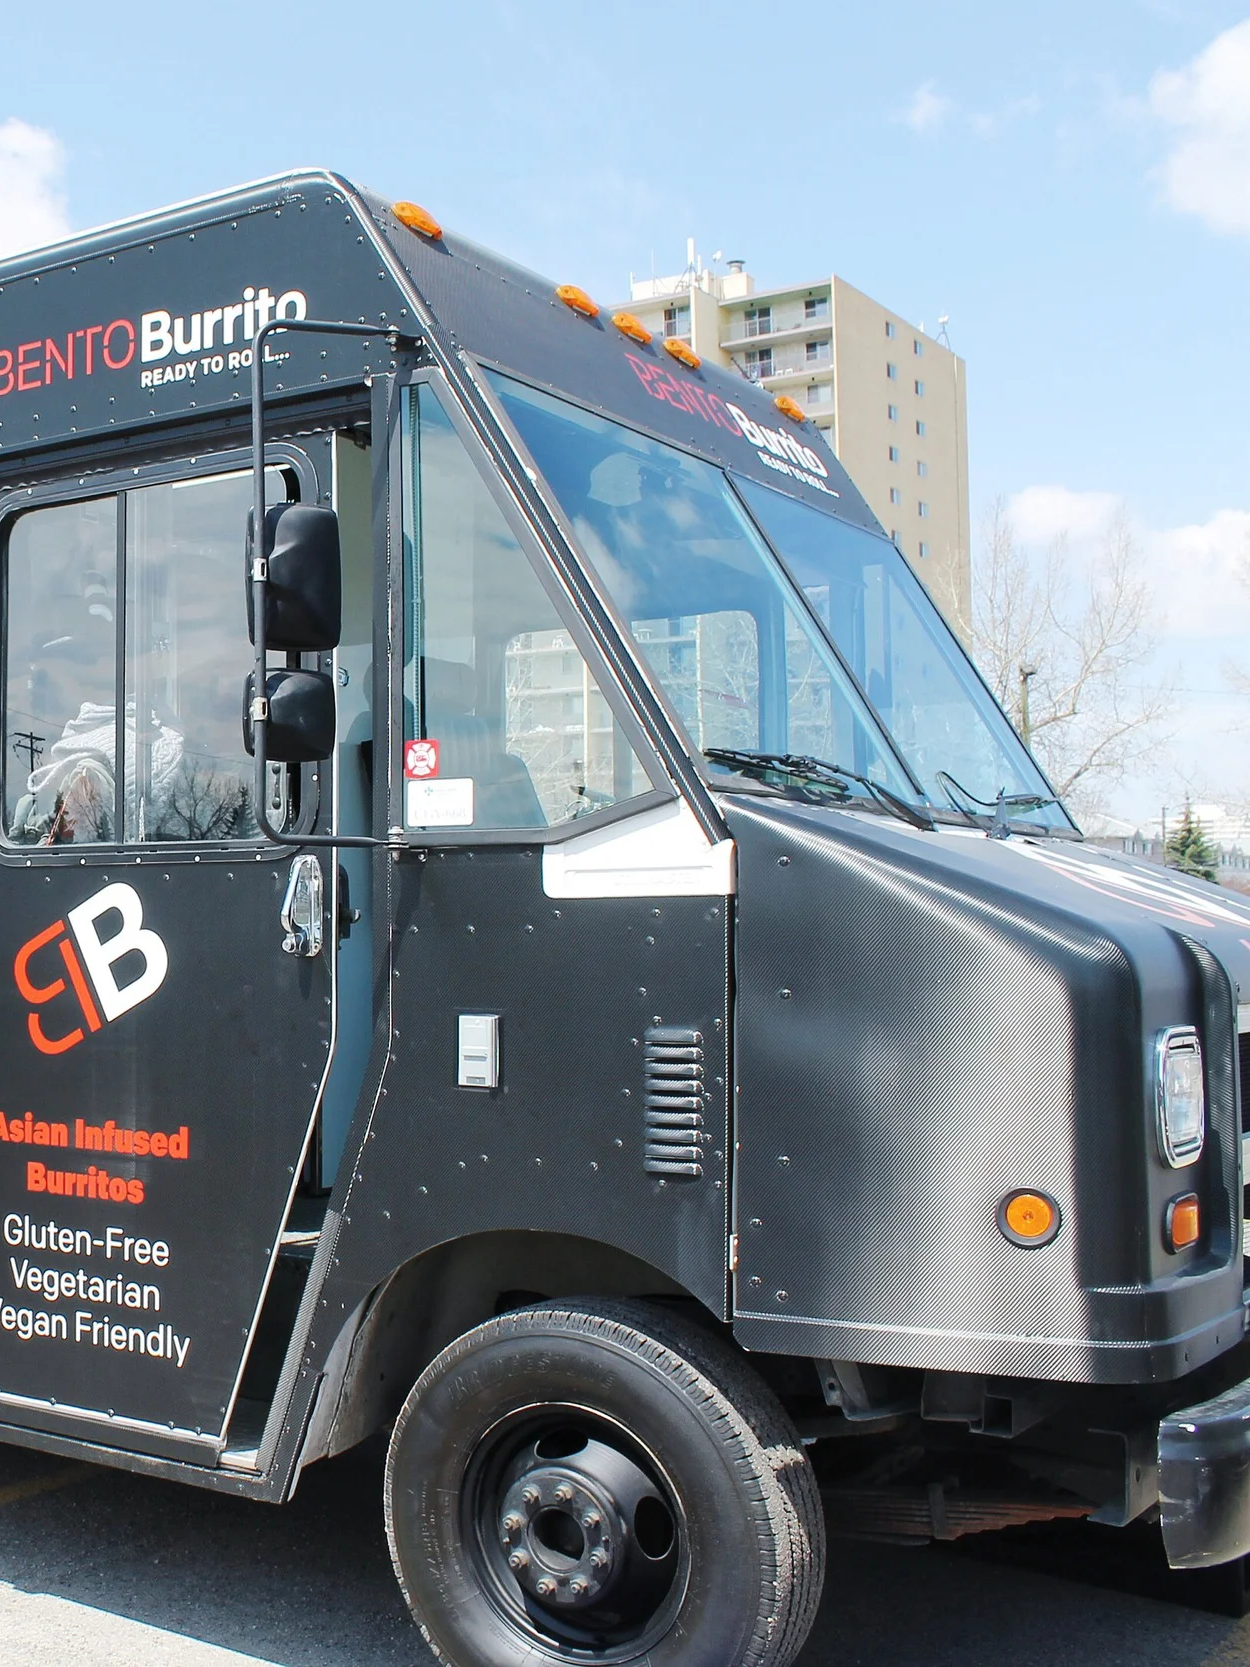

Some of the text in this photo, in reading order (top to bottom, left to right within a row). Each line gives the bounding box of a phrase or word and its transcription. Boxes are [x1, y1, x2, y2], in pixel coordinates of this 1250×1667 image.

[140, 286, 307, 364] Burrito
[140, 345, 290, 389] READY TO ROL...
[624, 353, 828, 478] BENTO Burrito
[75, 1118, 190, 1160] Infused
[26, 1161, 145, 1205] Burritos
[3, 1212, 171, 1267] Gluten-Free
[10, 1256, 161, 1312] Vegetarian
[75, 1310, 191, 1368] Friendly
